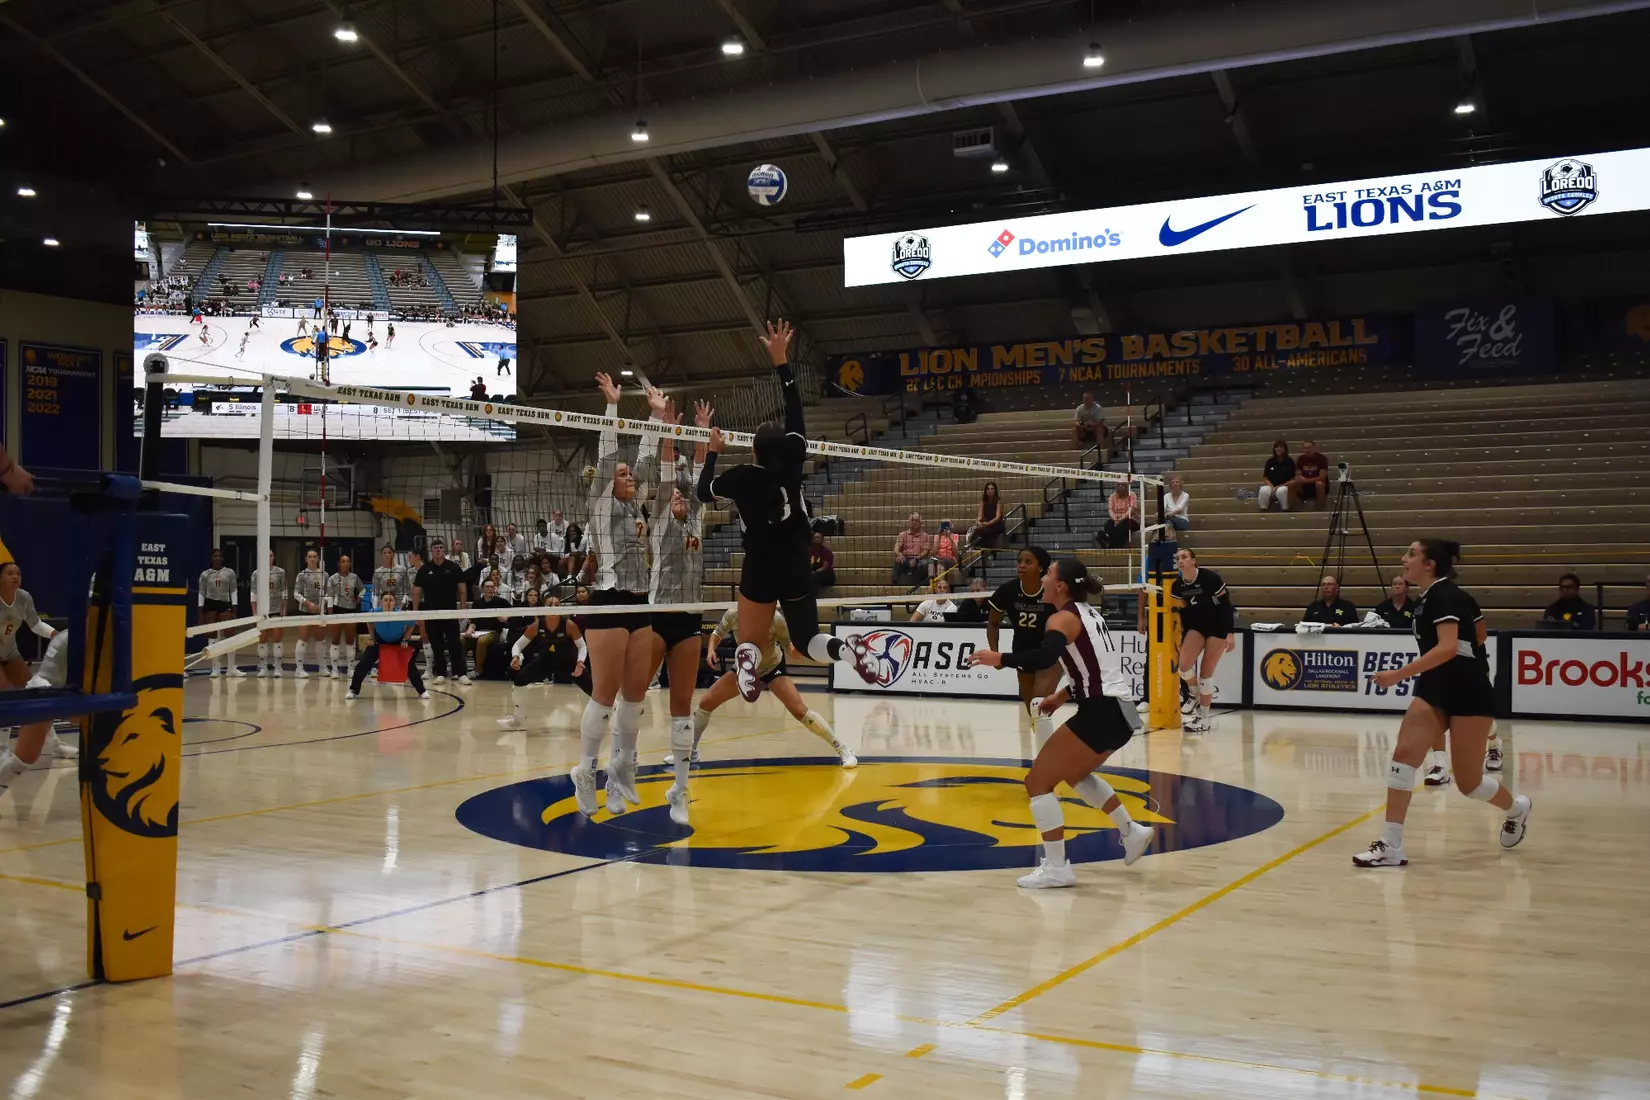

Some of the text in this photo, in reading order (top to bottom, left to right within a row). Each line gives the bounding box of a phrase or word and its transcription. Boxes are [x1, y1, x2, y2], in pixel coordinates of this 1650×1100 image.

[1302, 179, 1462, 204] EAST TEXAS A&M
[1543, 176, 1594, 194] LOREDO
[1303, 190, 1462, 232] LIONS
[1019, 228, 1121, 256] Domino's
[893, 247, 929, 262] LOREDO
[1444, 304, 1517, 341] Fix &
[899, 319, 1379, 376] LION MEN'S BASKETBALL
[1456, 332, 1523, 366] Feed
[1232, 349, 1367, 372] 30 ALL-AMERICANS
[1059, 359, 1200, 382] 7 NCAA TOURNAMENTS
[27, 375, 58, 387] 2019
[948, 370, 1041, 389] CHMPIONSHIPS
[27, 388, 58, 401] 2021
[337, 387, 357, 396] EAST
[359, 389, 383, 400] TEXAS
[28, 401, 61, 415] 2022
[421, 397, 440, 406] EAST
[441, 400, 463, 410] TEXAS
[497, 406, 514, 415] EAST
[516, 409, 536, 418] TEXAS
[583, 416, 600, 425] TEXAS
[628, 422, 642, 430] EAST
[644, 424, 659, 432] TEXAS
[141, 542, 166, 552] EAST
[137, 555, 168, 565] TEXAS
[133, 567, 170, 582] A&M
[1018, 612, 1037, 628] 22
[1303, 652, 1356, 667] Hilton
[1363, 652, 1418, 672] BEST
[1517, 650, 1650, 688] Brook
